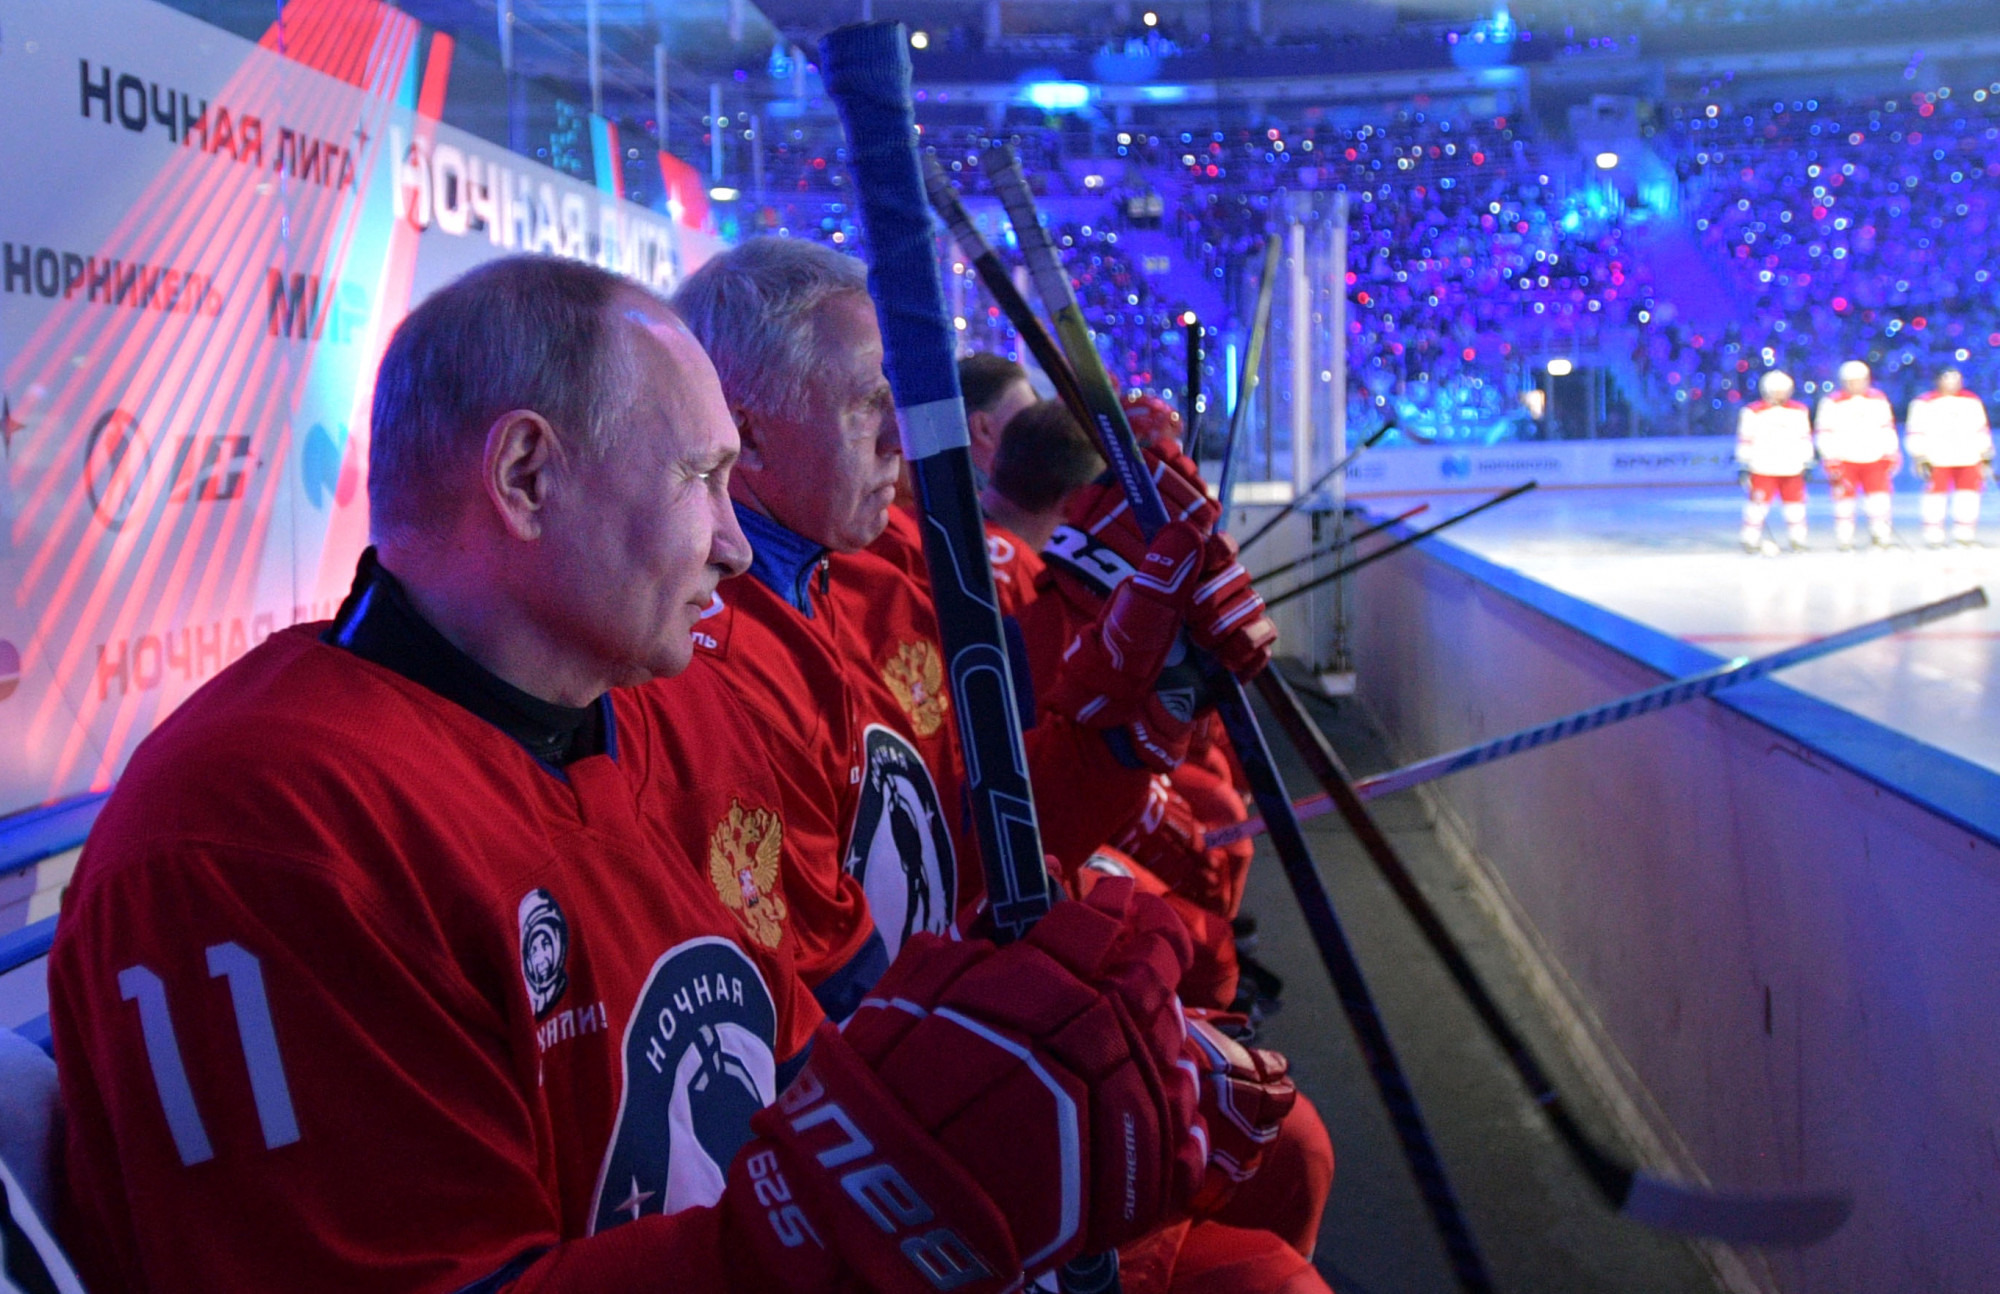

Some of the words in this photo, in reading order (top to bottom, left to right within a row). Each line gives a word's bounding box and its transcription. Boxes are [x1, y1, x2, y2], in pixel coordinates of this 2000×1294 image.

[79, 57, 262, 169] НОЧНАЯ
[273, 126, 356, 192] ЛИГА
[389, 124, 590, 262] НОЧНАЯ
[3, 242, 223, 317] НОРНИКЕЛЬ
[117, 941, 301, 1168] 11
[646, 972, 744, 1074] НОЧНАЯ
[781, 1066, 998, 1291] BAUE
